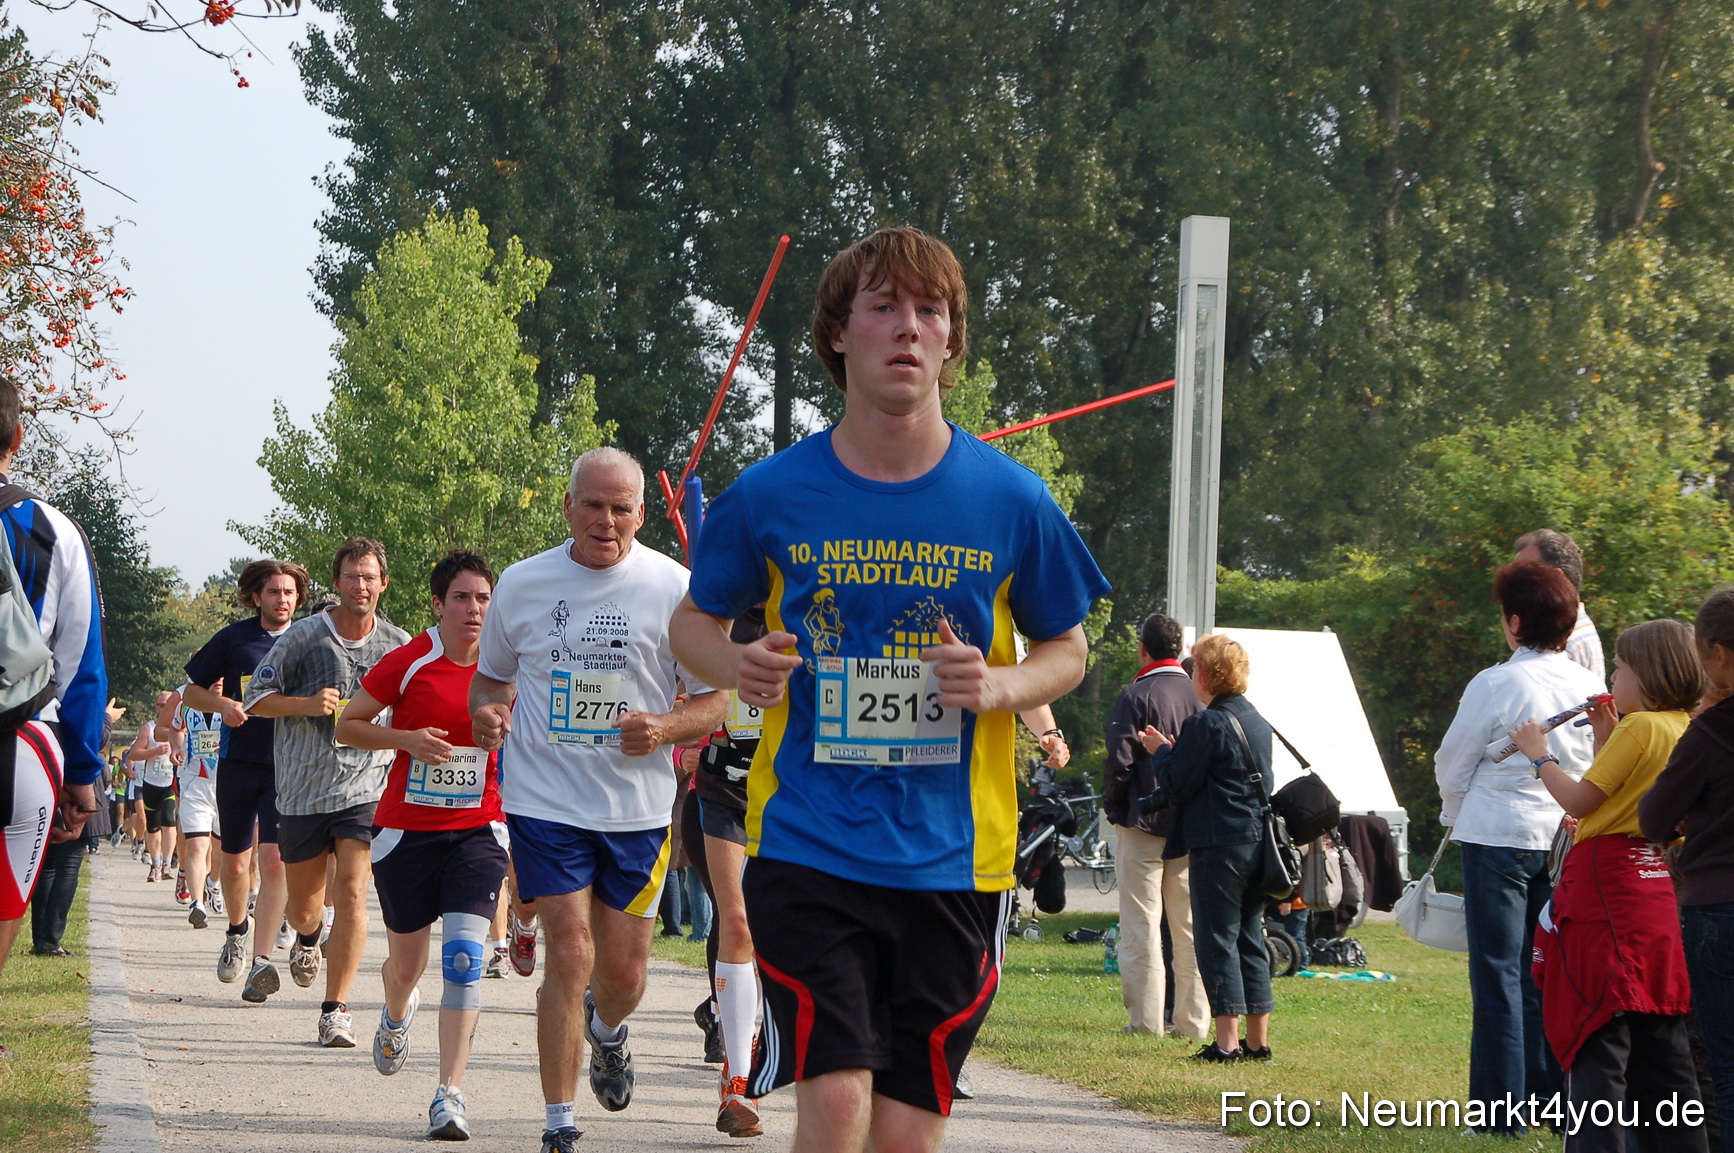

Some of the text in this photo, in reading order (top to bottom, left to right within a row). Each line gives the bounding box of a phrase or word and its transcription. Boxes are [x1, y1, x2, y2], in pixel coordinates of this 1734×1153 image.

[788, 540, 994, 572] 10. NEUMARKTER
[818, 563, 958, 589] STADTLAUF
[585, 627, 629, 637] 21.09.2008
[550, 649, 627, 663] 9. Neumarkter
[583, 660, 627, 671] Stadtlauf
[856, 658, 921, 679] Markus
[575, 679, 602, 694] Hans
[555, 697, 562, 708] C
[825, 689, 833, 704] C
[575, 701, 629, 720] 2776
[858, 692, 944, 723] 2513
[905, 746, 958, 757] PFLEIDERER
[431, 769, 477, 786] 3333
